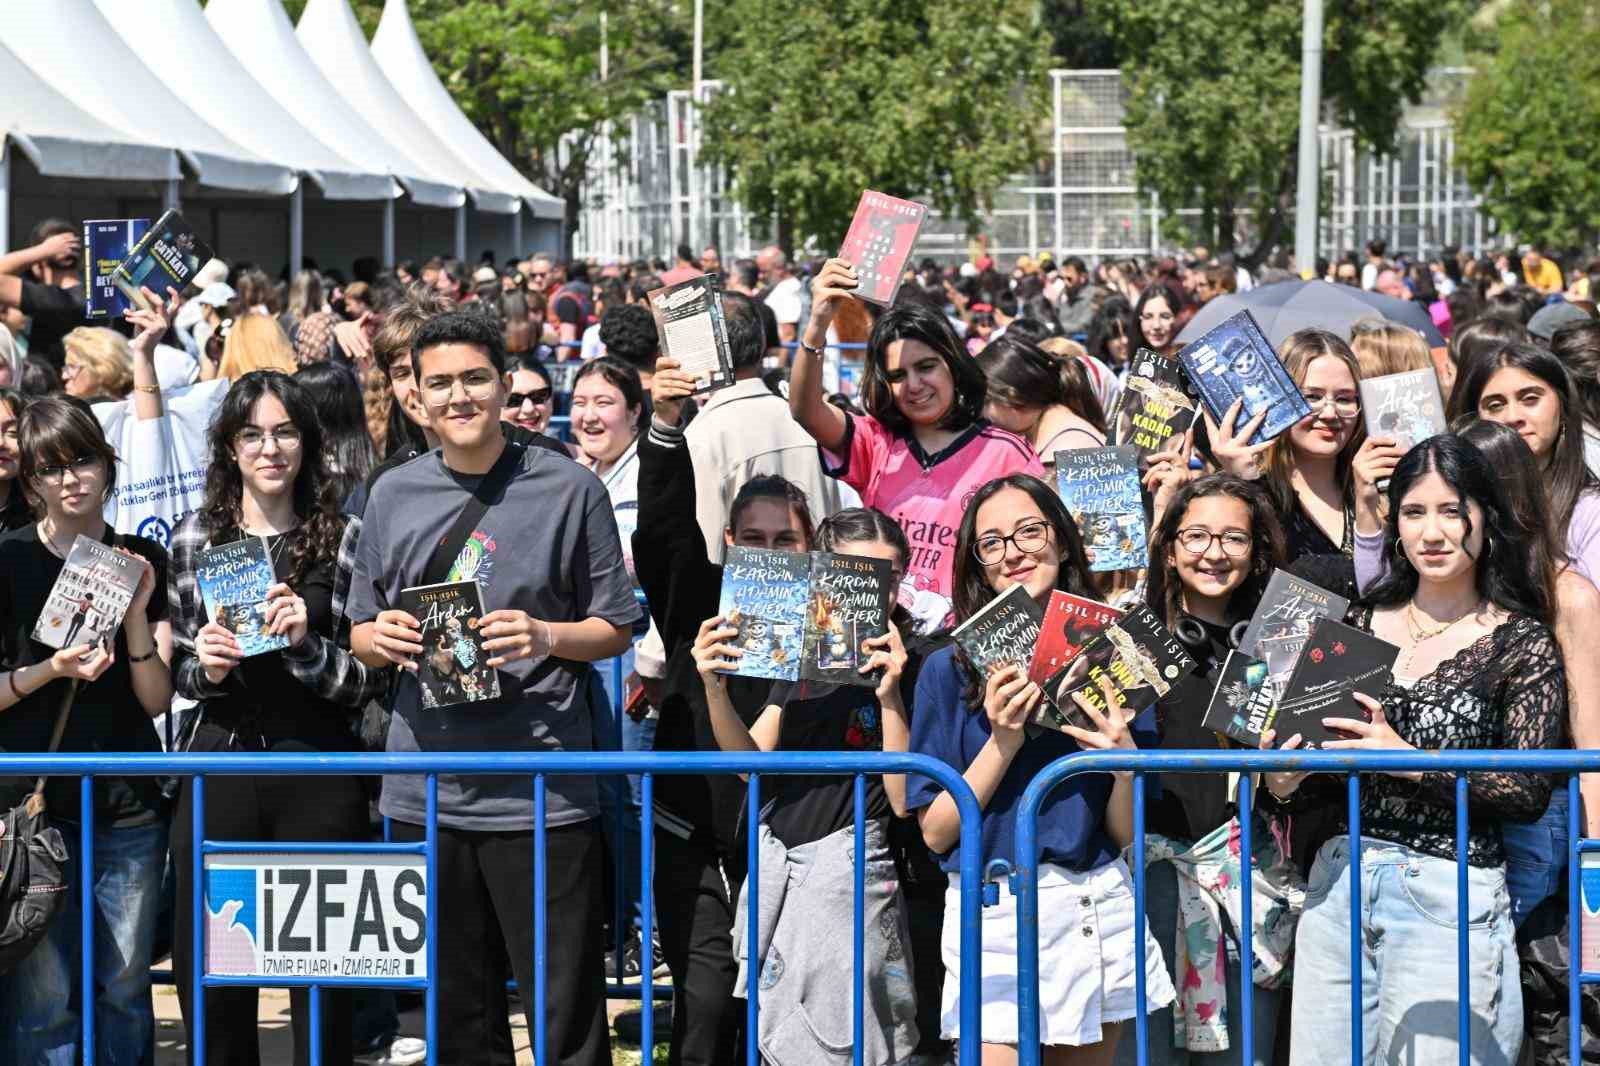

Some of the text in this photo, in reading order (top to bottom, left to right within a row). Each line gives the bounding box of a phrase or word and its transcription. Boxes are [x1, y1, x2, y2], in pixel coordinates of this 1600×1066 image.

[1132, 413, 1173, 438] KADAR
[1134, 432, 1160, 450] SAY
[1065, 463, 1125, 484] KARDAN
[732, 565, 793, 586] KARDAN
[818, 571, 880, 593] KARDAN
[825, 590, 880, 609] ADAMIN
[976, 607, 1030, 658] KARDAN
[1110, 660, 1136, 689] ONA
[263, 954, 294, 974] İZMİR
[341, 955, 373, 975] İZMİR
[375, 958, 401, 975] FAIR
